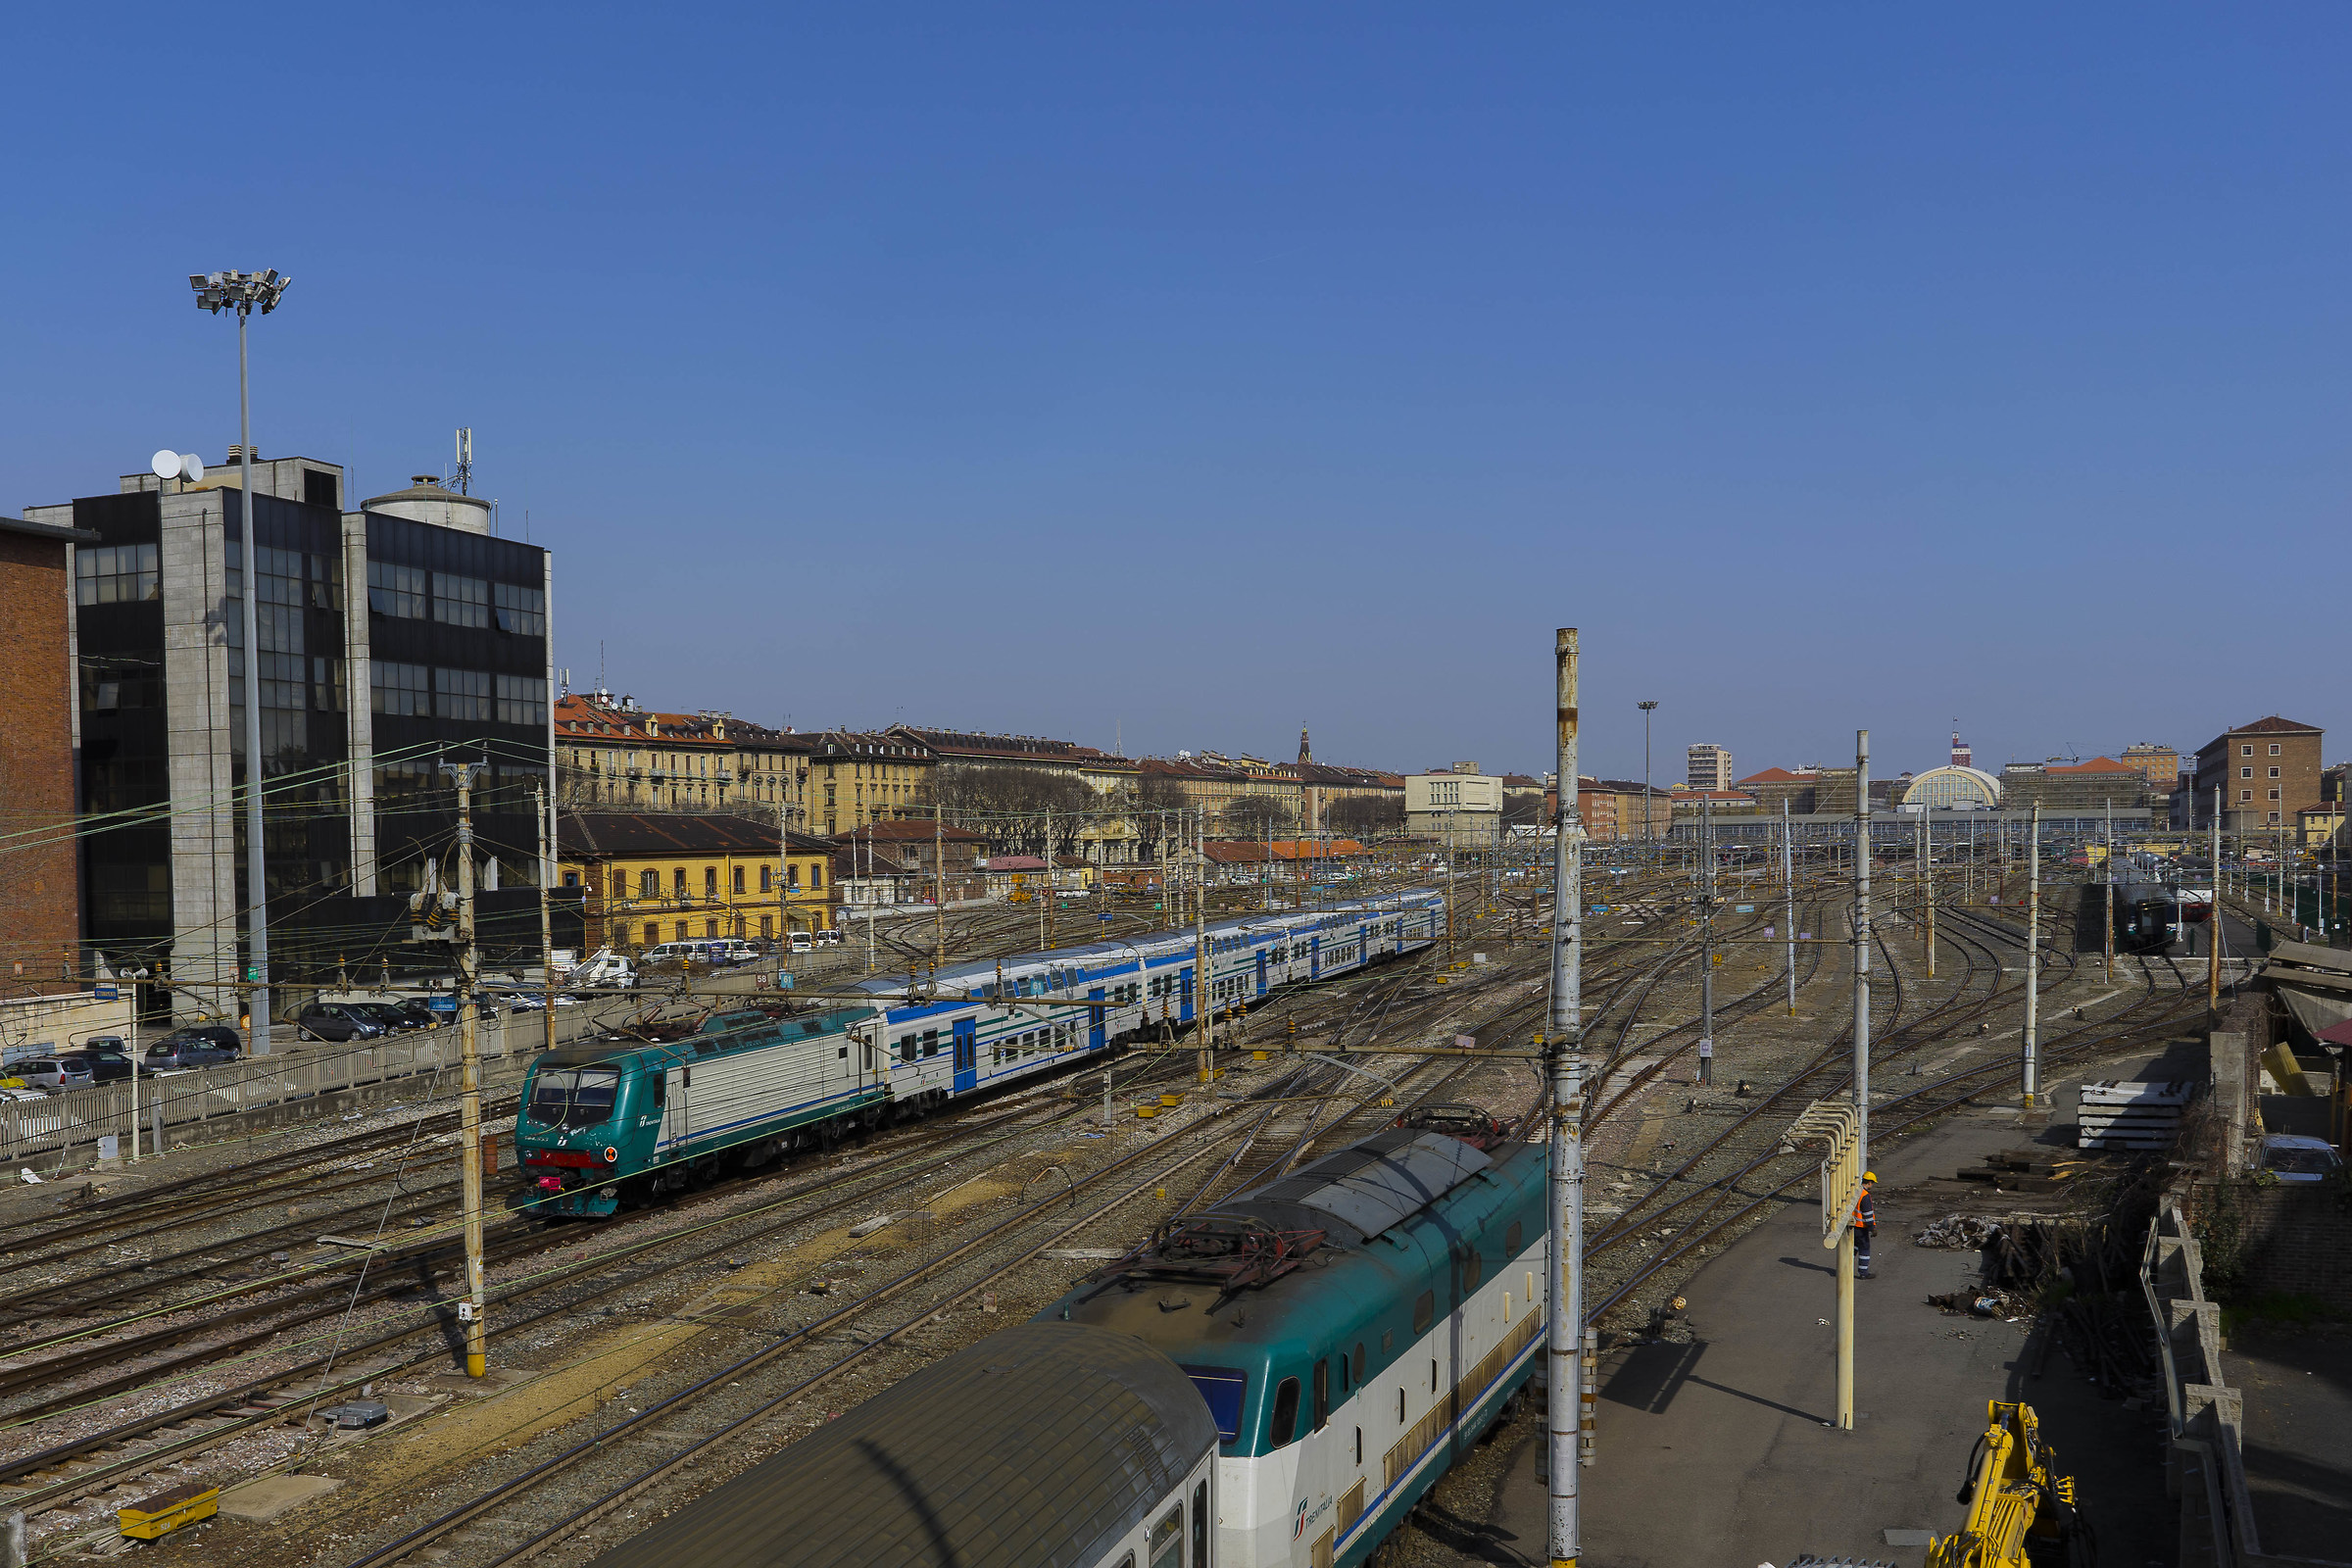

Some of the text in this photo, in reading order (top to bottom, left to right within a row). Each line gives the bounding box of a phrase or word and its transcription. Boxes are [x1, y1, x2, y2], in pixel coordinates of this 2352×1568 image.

[554, 972, 564, 981] 58
[783, 975, 791, 984] 61
[1032, 981, 1042, 990] 61
[1305, 1494, 1333, 1529] TRENITALIA
